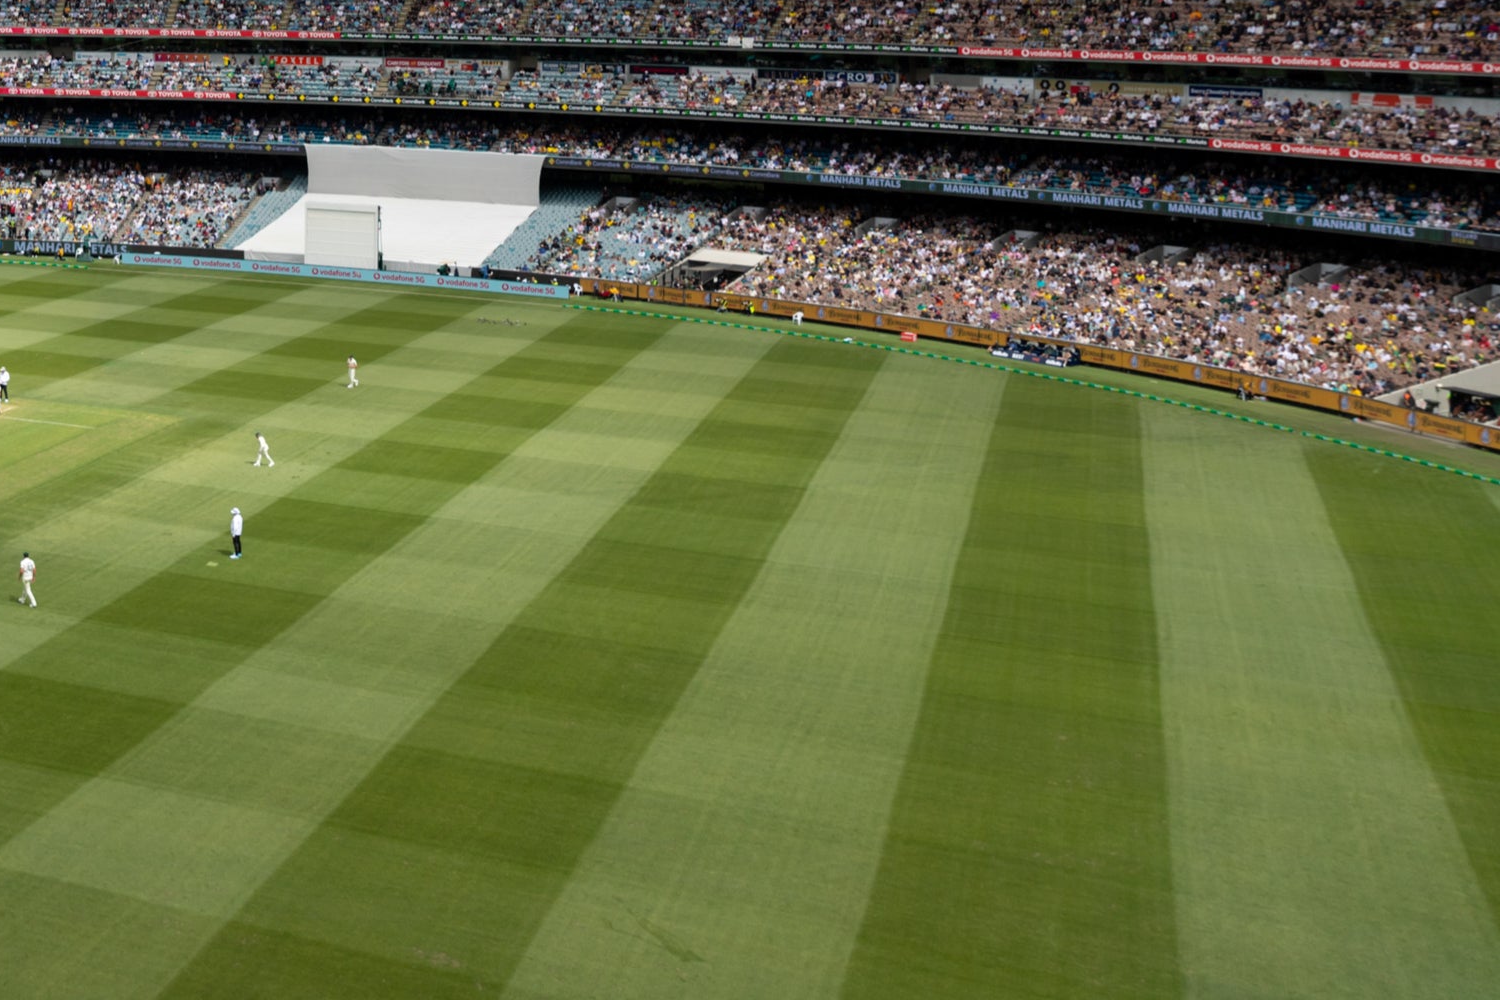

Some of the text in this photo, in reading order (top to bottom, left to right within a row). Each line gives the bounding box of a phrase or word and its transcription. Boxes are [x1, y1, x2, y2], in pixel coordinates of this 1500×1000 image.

[1090, 51, 1124, 59] vodafone
[1280, 58, 1319, 66] vodafone
[1350, 60, 1388, 68] vodafone
[1420, 62, 1460, 71] vodafone
[30, 136, 61, 144] METALS
[1222, 140, 1259, 149] vodafone
[1291, 145, 1329, 155] vodafone
[1359, 150, 1399, 160] vodafone
[1431, 156, 1472, 166] vodafone
[820, 175, 901, 188] MANHARI METALS
[943, 184, 1029, 199] MANHARI METALS
[1053, 192, 1144, 209] MANHARI METALS
[1168, 203, 1263, 221] MANHARI METALS
[1312, 217, 1415, 237] MANHARI METALS
[14, 241, 127, 255] MANHARI ETALS
[201, 260, 231, 268] vodafone
[320, 269, 351, 277] vodafone
[382, 274, 414, 282] vodafone
[446, 279, 489, 289] vodafone 5G
[511, 284, 544, 293] vodafone
